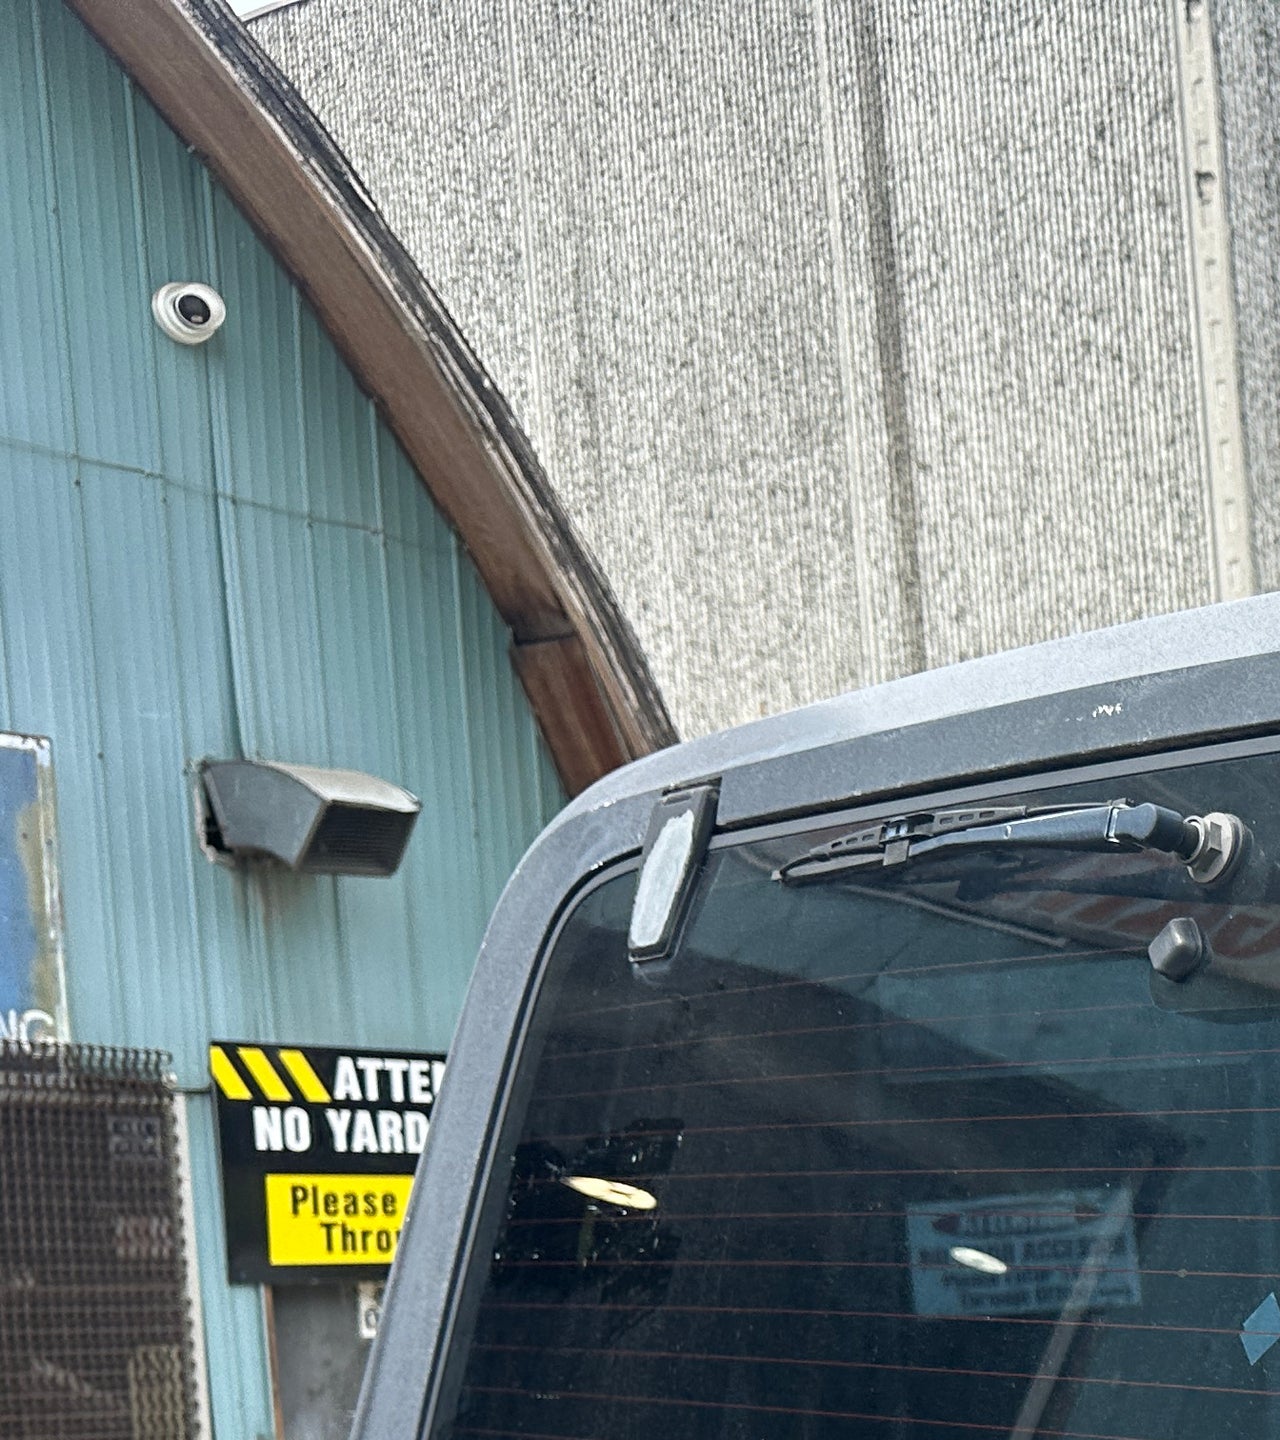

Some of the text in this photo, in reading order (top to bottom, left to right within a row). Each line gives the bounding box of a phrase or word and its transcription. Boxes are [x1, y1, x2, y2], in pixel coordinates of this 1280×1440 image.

[252, 1105, 430, 1154] NO YARD
[290, 1184, 398, 1218] Please
[319, 1222, 402, 1253] Thro
